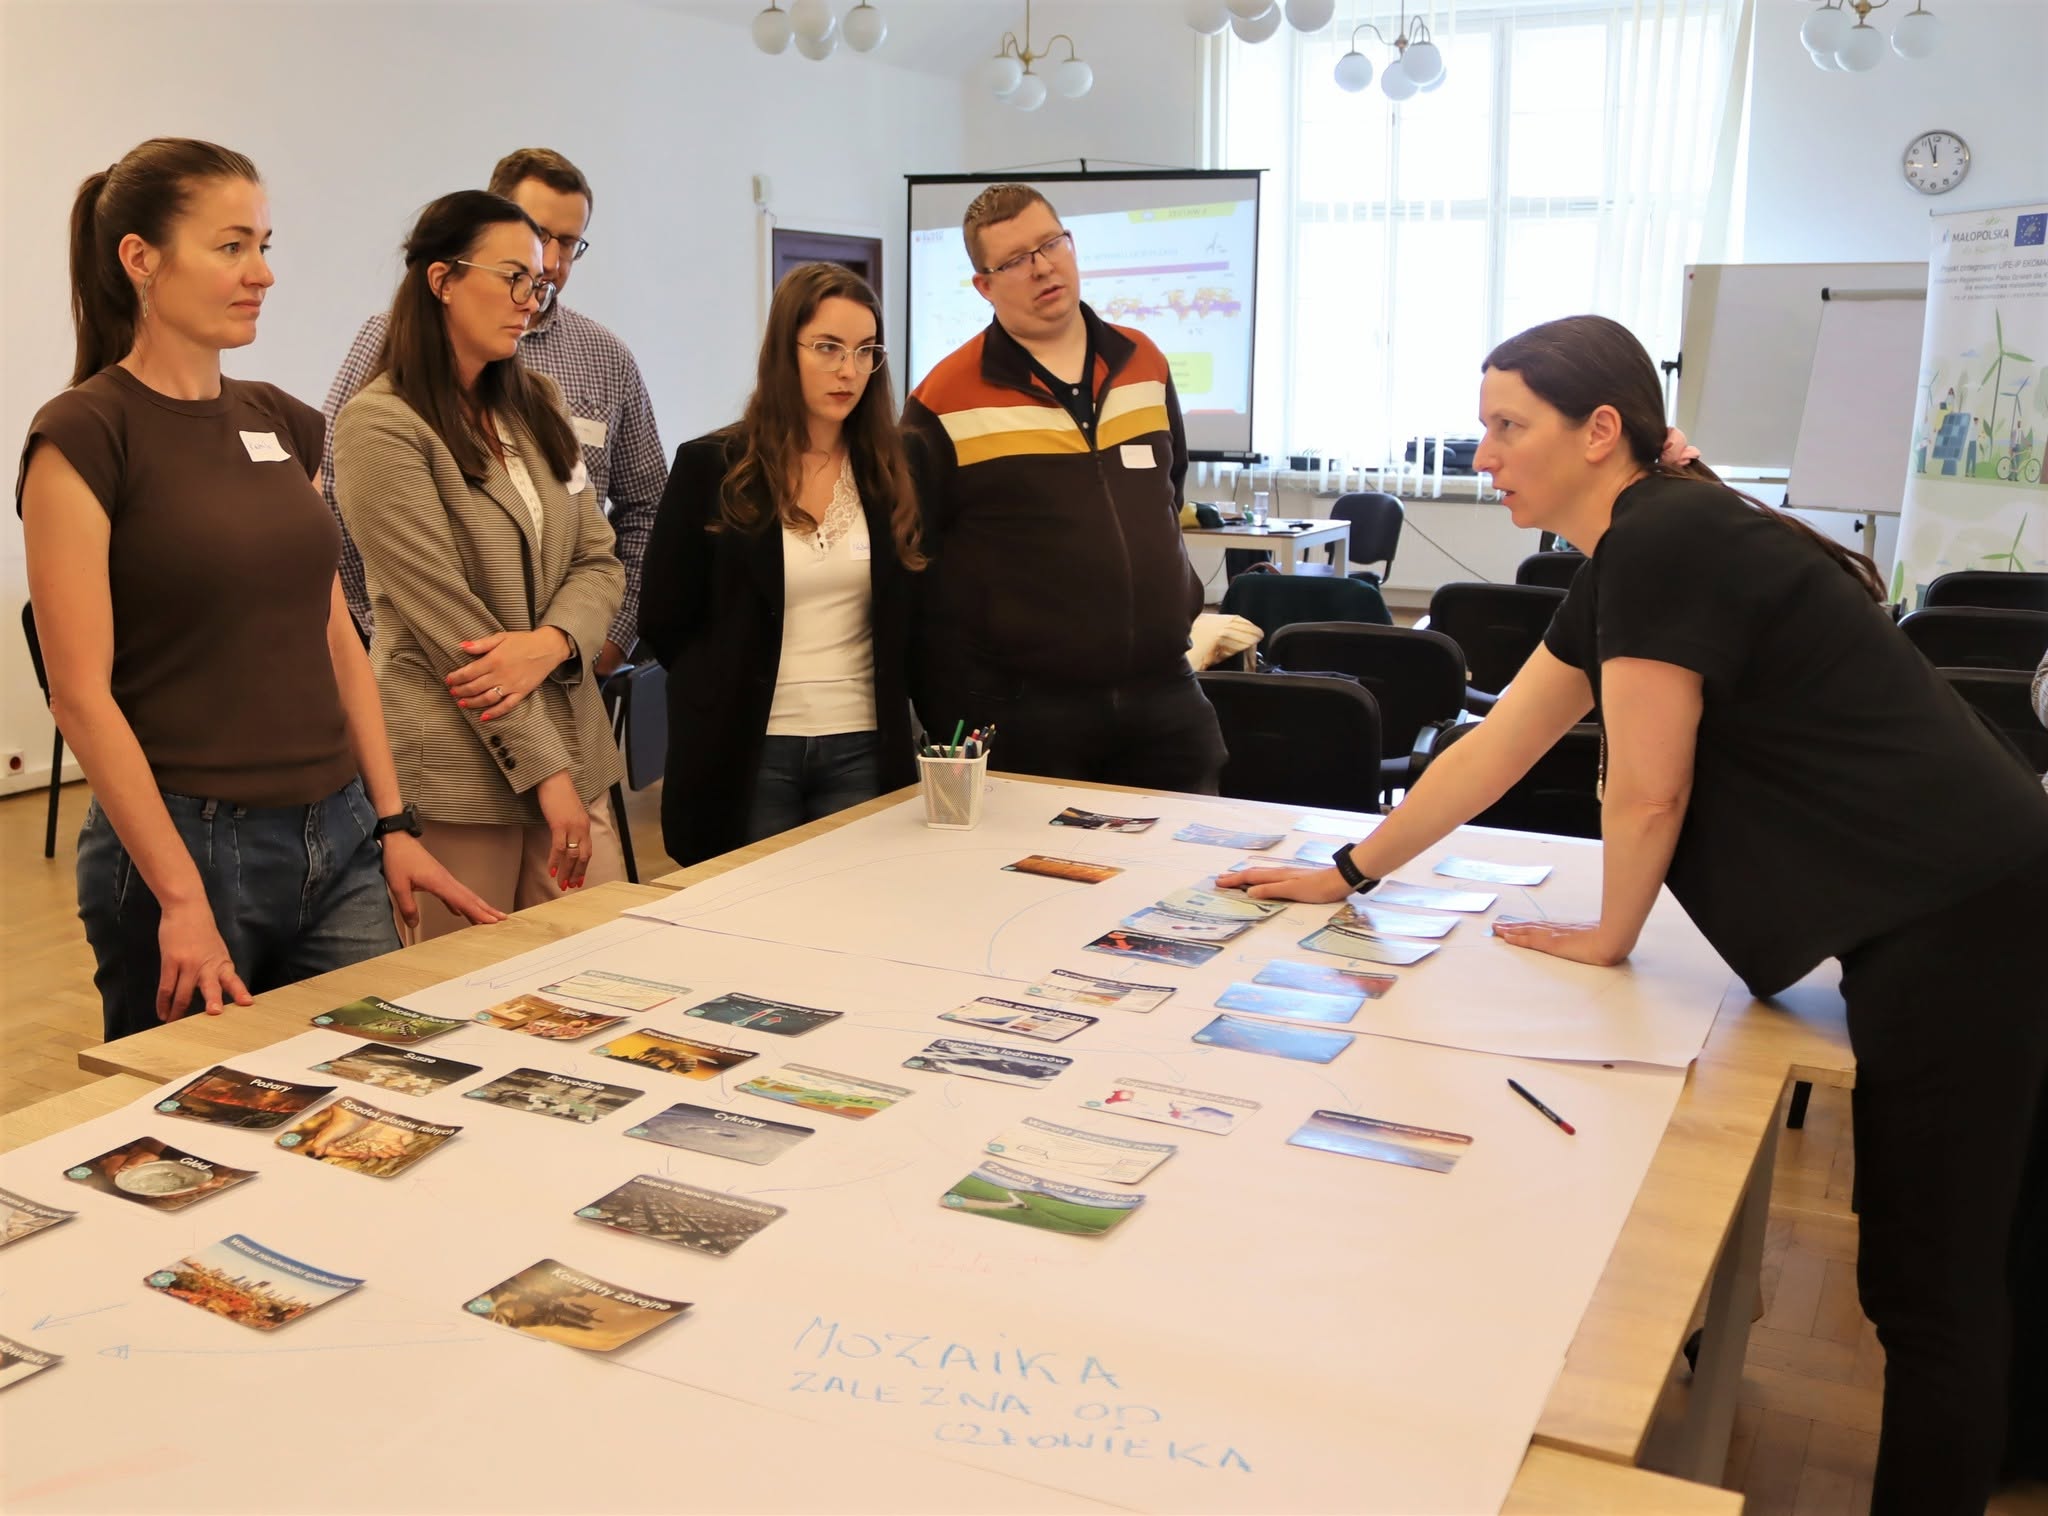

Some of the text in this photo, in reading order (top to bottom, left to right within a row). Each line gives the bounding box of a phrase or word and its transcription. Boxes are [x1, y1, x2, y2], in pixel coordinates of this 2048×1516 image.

[1952, 229, 2009, 242] MAŁOPOLSKA
[403, 1052, 438, 1064] Susze
[999, 1047, 1068, 1065] lodowców
[250, 1078, 293, 1093] Pożary
[546, 1073, 605, 1091] Powodzie
[340, 1099, 456, 1137] Spadek plonów rolnych
[714, 1112, 767, 1129] Cyklony
[1026, 1117, 1071, 1136] Wzrost
[179, 1157, 212, 1171] Głód
[985, 1161, 1141, 1204] Zasoby wód słodkich
[712, 1197, 778, 1217] nadmorskich
[551, 1267, 672, 1312] Konflikty zbrojne
[1073, 1402, 1161, 1425] OD
